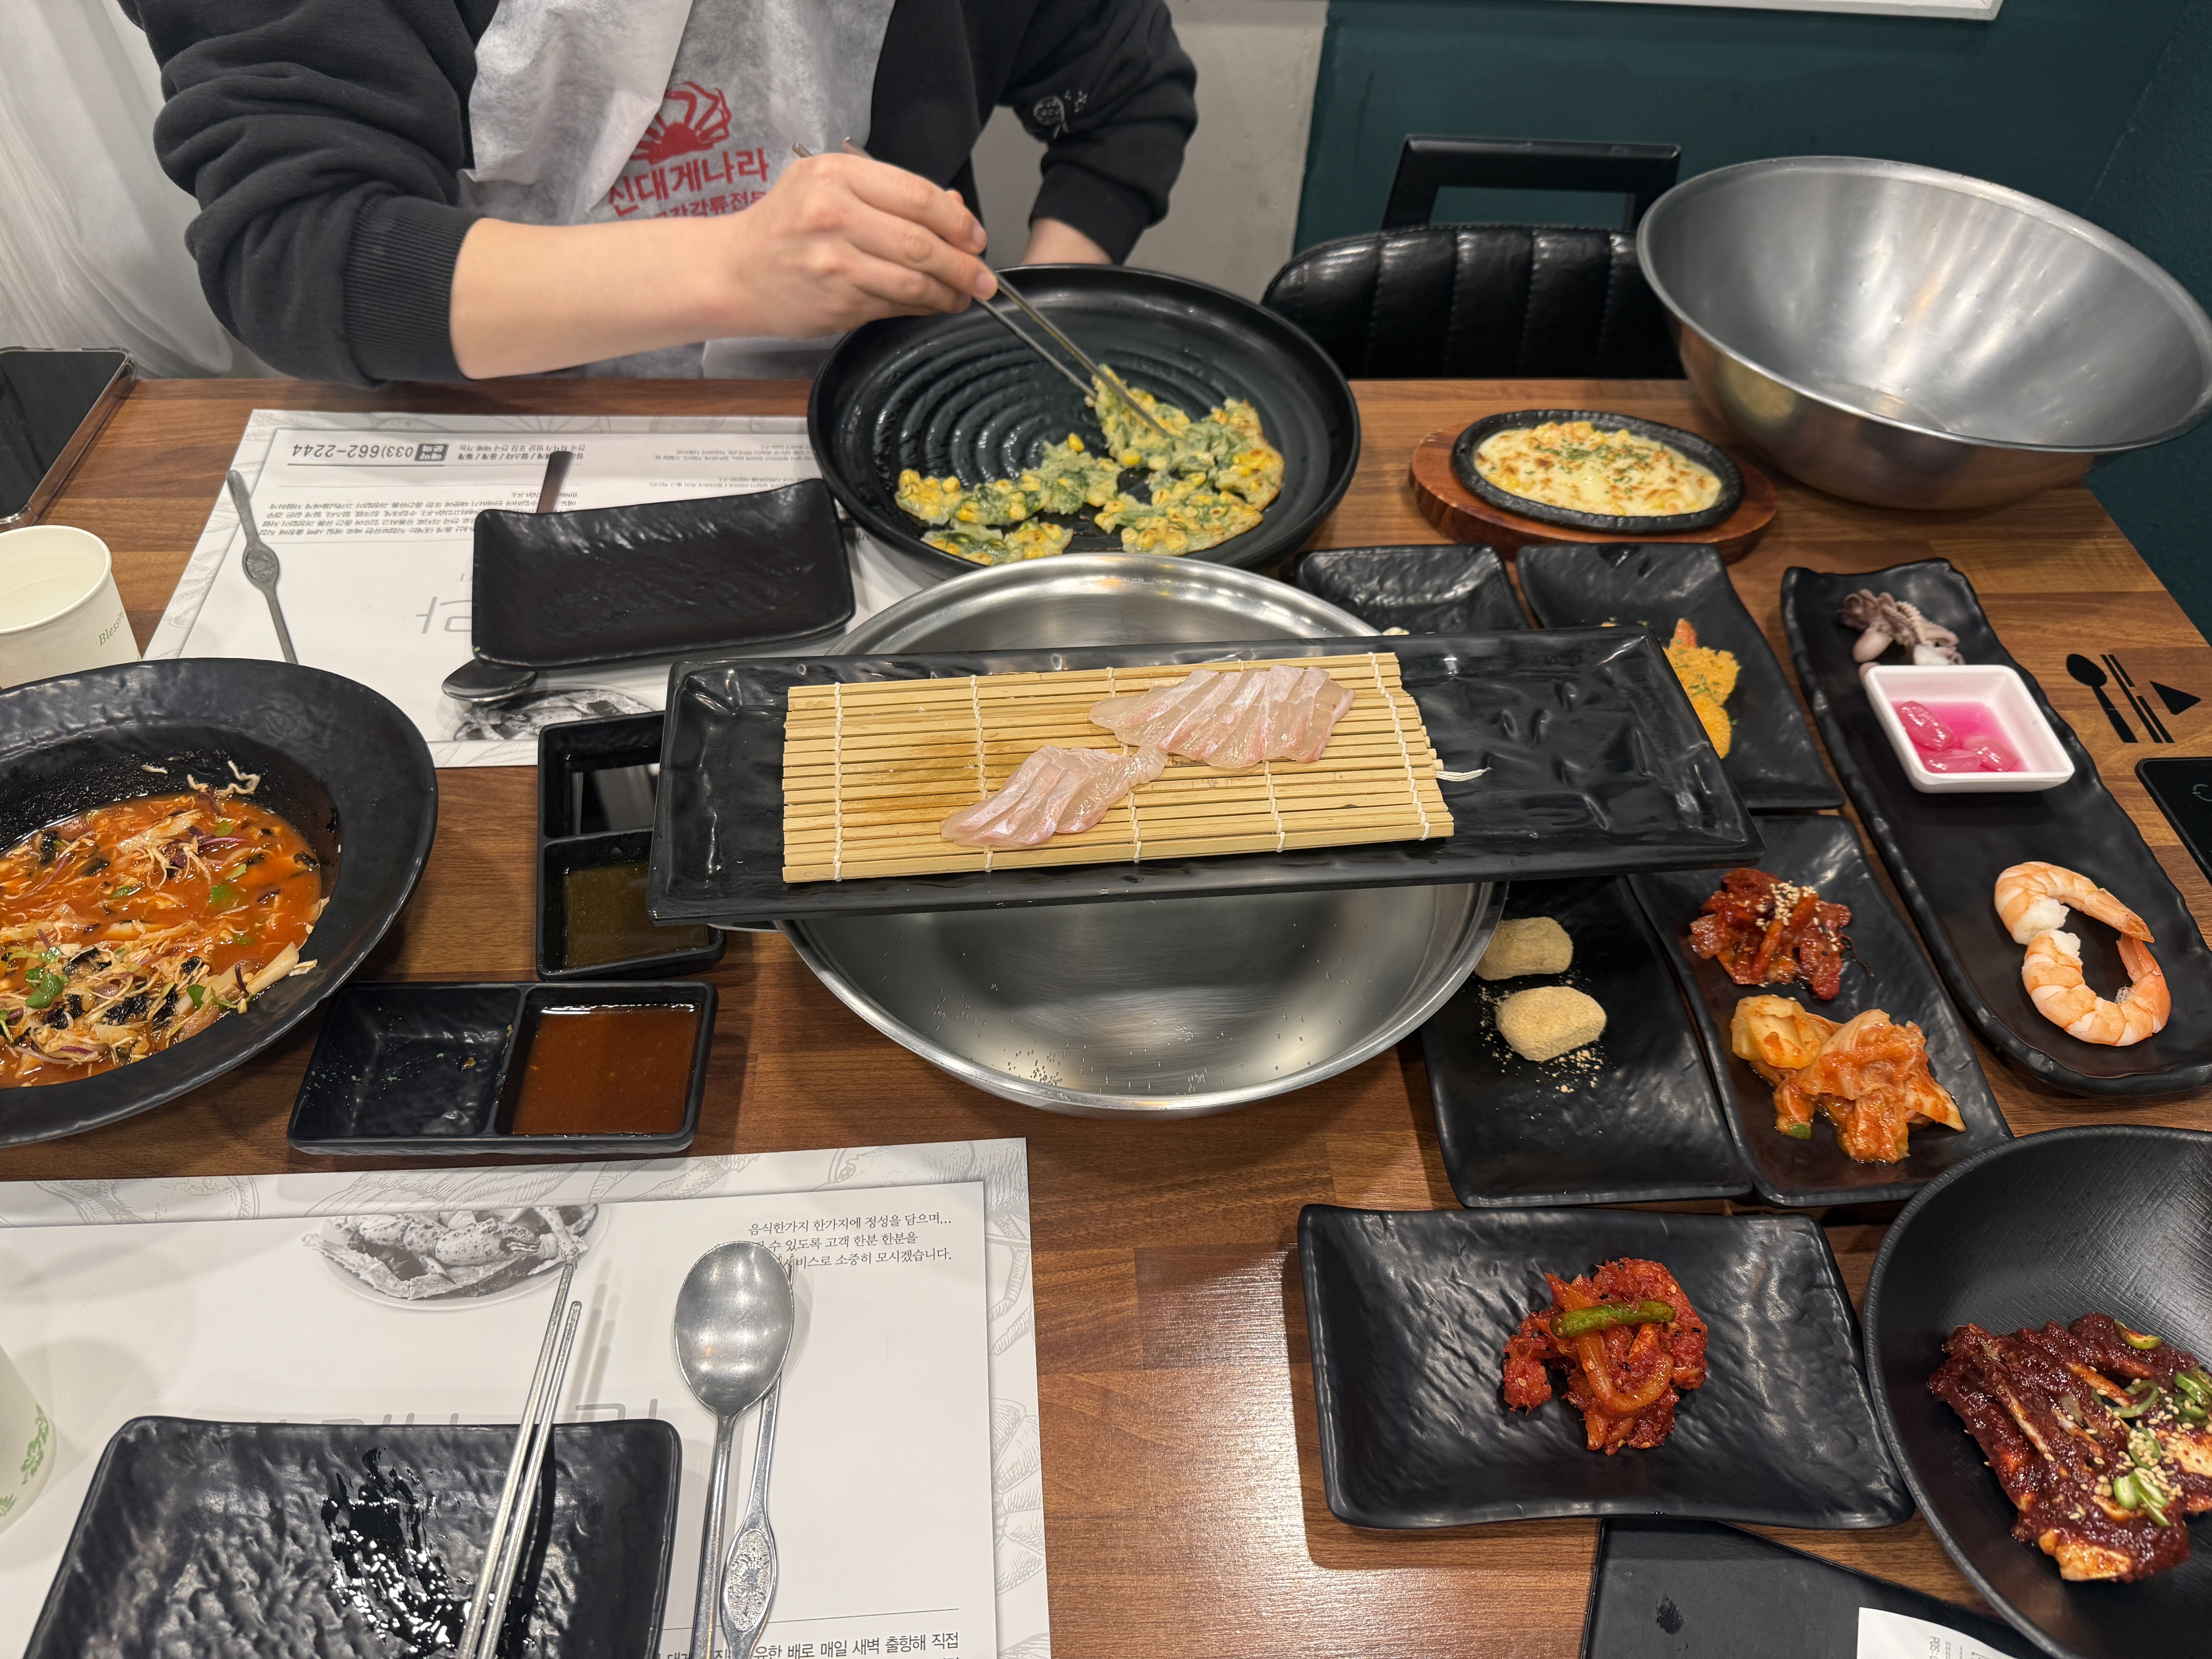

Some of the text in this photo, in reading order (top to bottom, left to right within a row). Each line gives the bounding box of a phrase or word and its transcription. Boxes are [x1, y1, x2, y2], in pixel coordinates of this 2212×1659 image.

[292, 445, 413, 458] 033)662-2244
[749, 1220, 809, 1235] 음식한가지
[813, 1217, 861, 1231] 한가지에
[866, 1215, 902, 1228] 정성을
[769, 1240, 782, 1252] 수
[786, 1238, 822, 1251] 있도록
[825, 1235, 849, 1248] 고객
[854, 1234, 878, 1247] 한분
[883, 1231, 918, 1245] 한분을
[836, 1252, 871, 1266] 소중히
[876, 1248, 951, 1262] 모시겠습니다.
[788, 1644, 815, 1658] 배로
[821, 1640, 847, 1658] 매일
[852, 1638, 879, 1655] 새벽
[886, 1634, 926, 1654] 출항해
[933, 1632, 958, 1649] 직접
